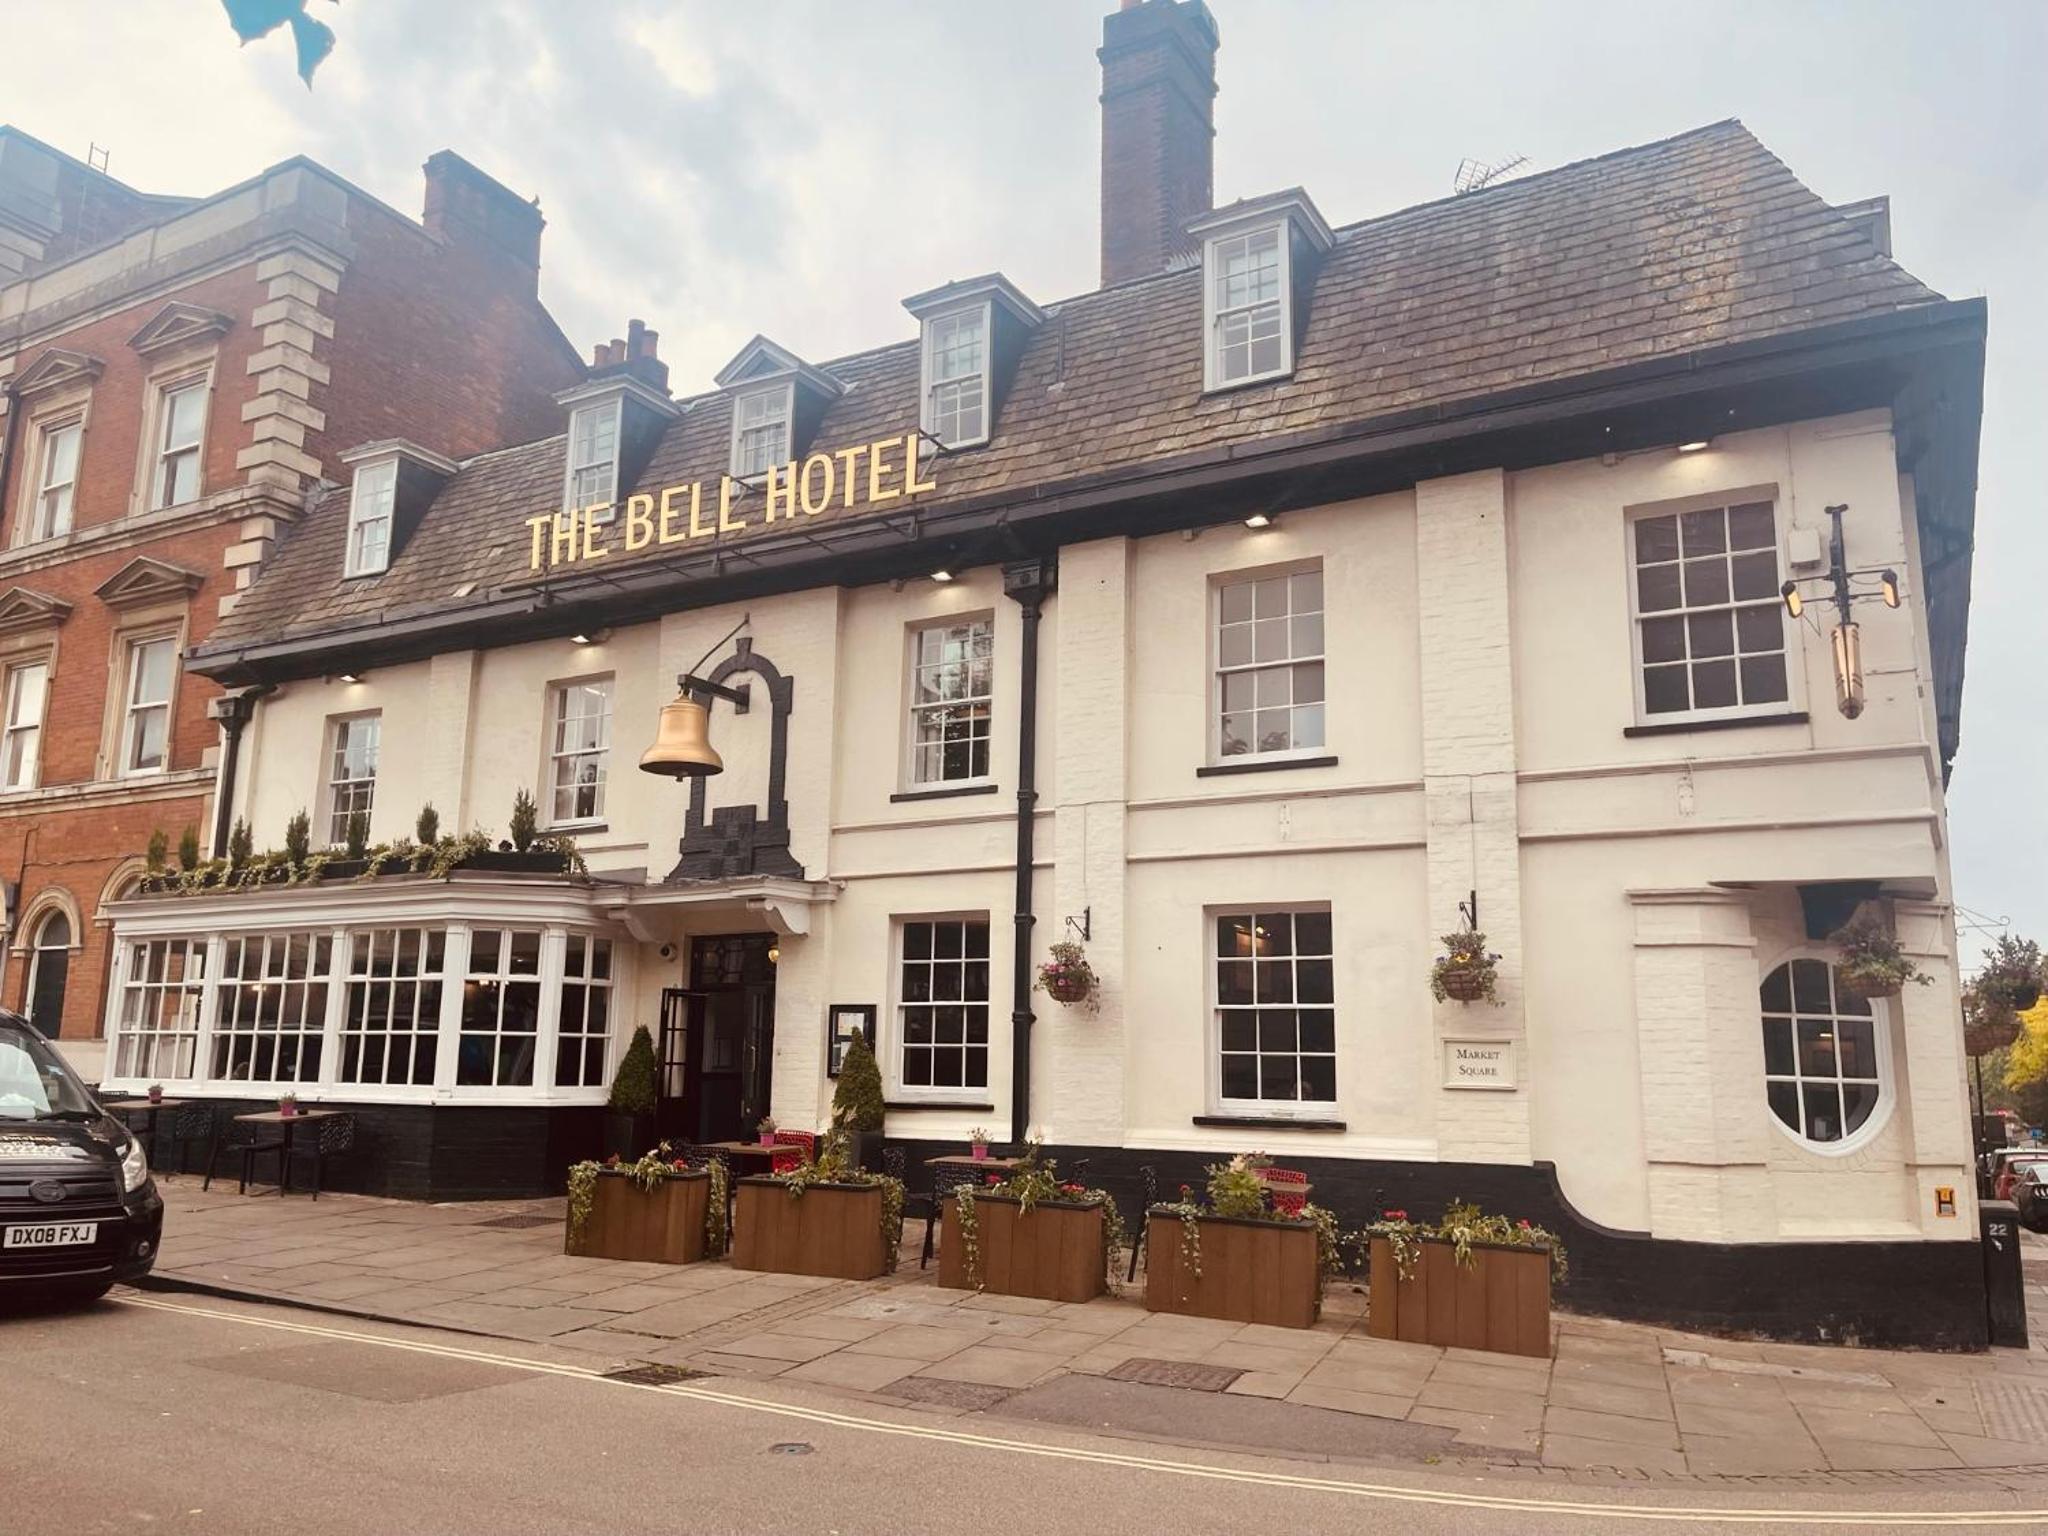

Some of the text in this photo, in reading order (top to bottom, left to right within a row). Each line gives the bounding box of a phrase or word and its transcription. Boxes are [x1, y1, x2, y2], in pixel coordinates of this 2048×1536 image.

[526, 434, 936, 569] THE BELL HOTEL
[1936, 1189, 1956, 1215] H
[12, 1226, 90, 1244] DX08 FXJ
[1989, 1223, 2008, 1236] 22
